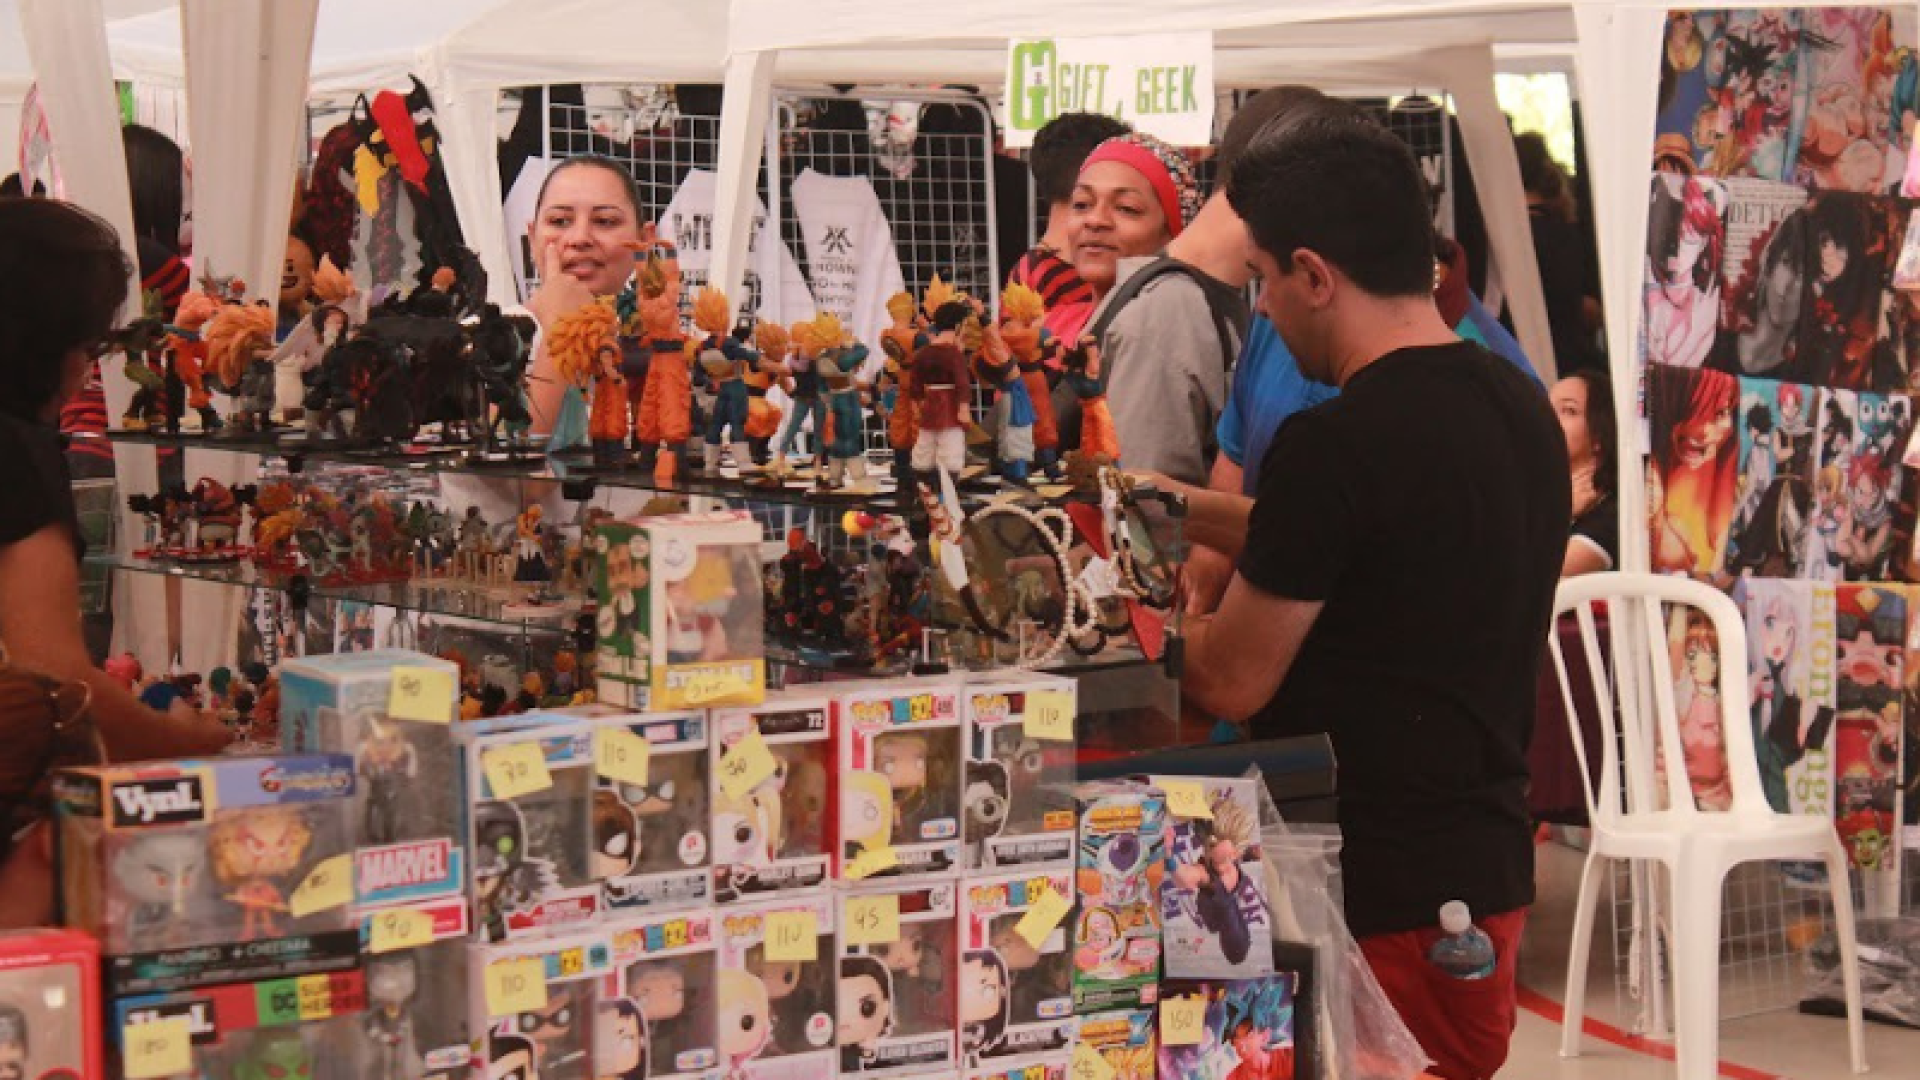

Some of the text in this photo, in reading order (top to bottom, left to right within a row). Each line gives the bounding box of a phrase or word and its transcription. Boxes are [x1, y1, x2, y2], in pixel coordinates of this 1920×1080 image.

[1059, 63, 1198, 115] GIFT GEEK
[359, 842, 449, 891] MARVEL
